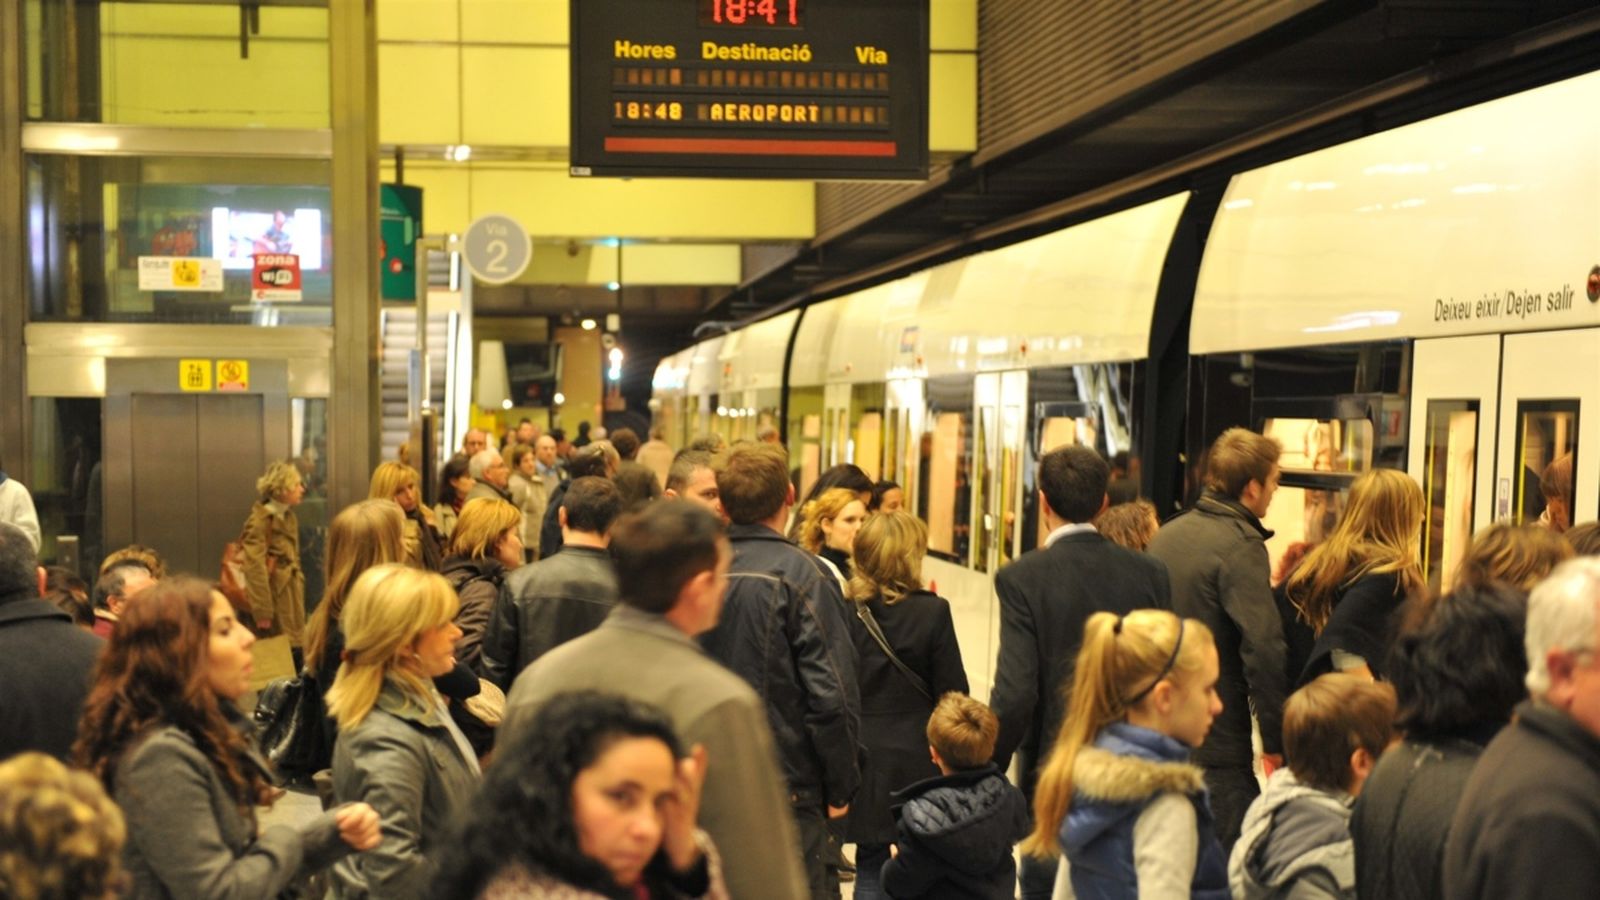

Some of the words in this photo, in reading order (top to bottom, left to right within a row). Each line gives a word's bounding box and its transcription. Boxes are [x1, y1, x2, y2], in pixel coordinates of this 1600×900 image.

[713, 0, 798, 24] 18:41
[614, 40, 676, 59] Hores
[702, 41, 812, 62] Destinació
[855, 46, 888, 64] Via
[615, 102, 682, 119] 18:48
[710, 103, 819, 122] AEROPORT
[485, 223, 507, 235] Via
[486, 239, 507, 272] 2
[1434, 297, 1472, 321] Deixeu
[1547, 283, 1575, 312] salir
